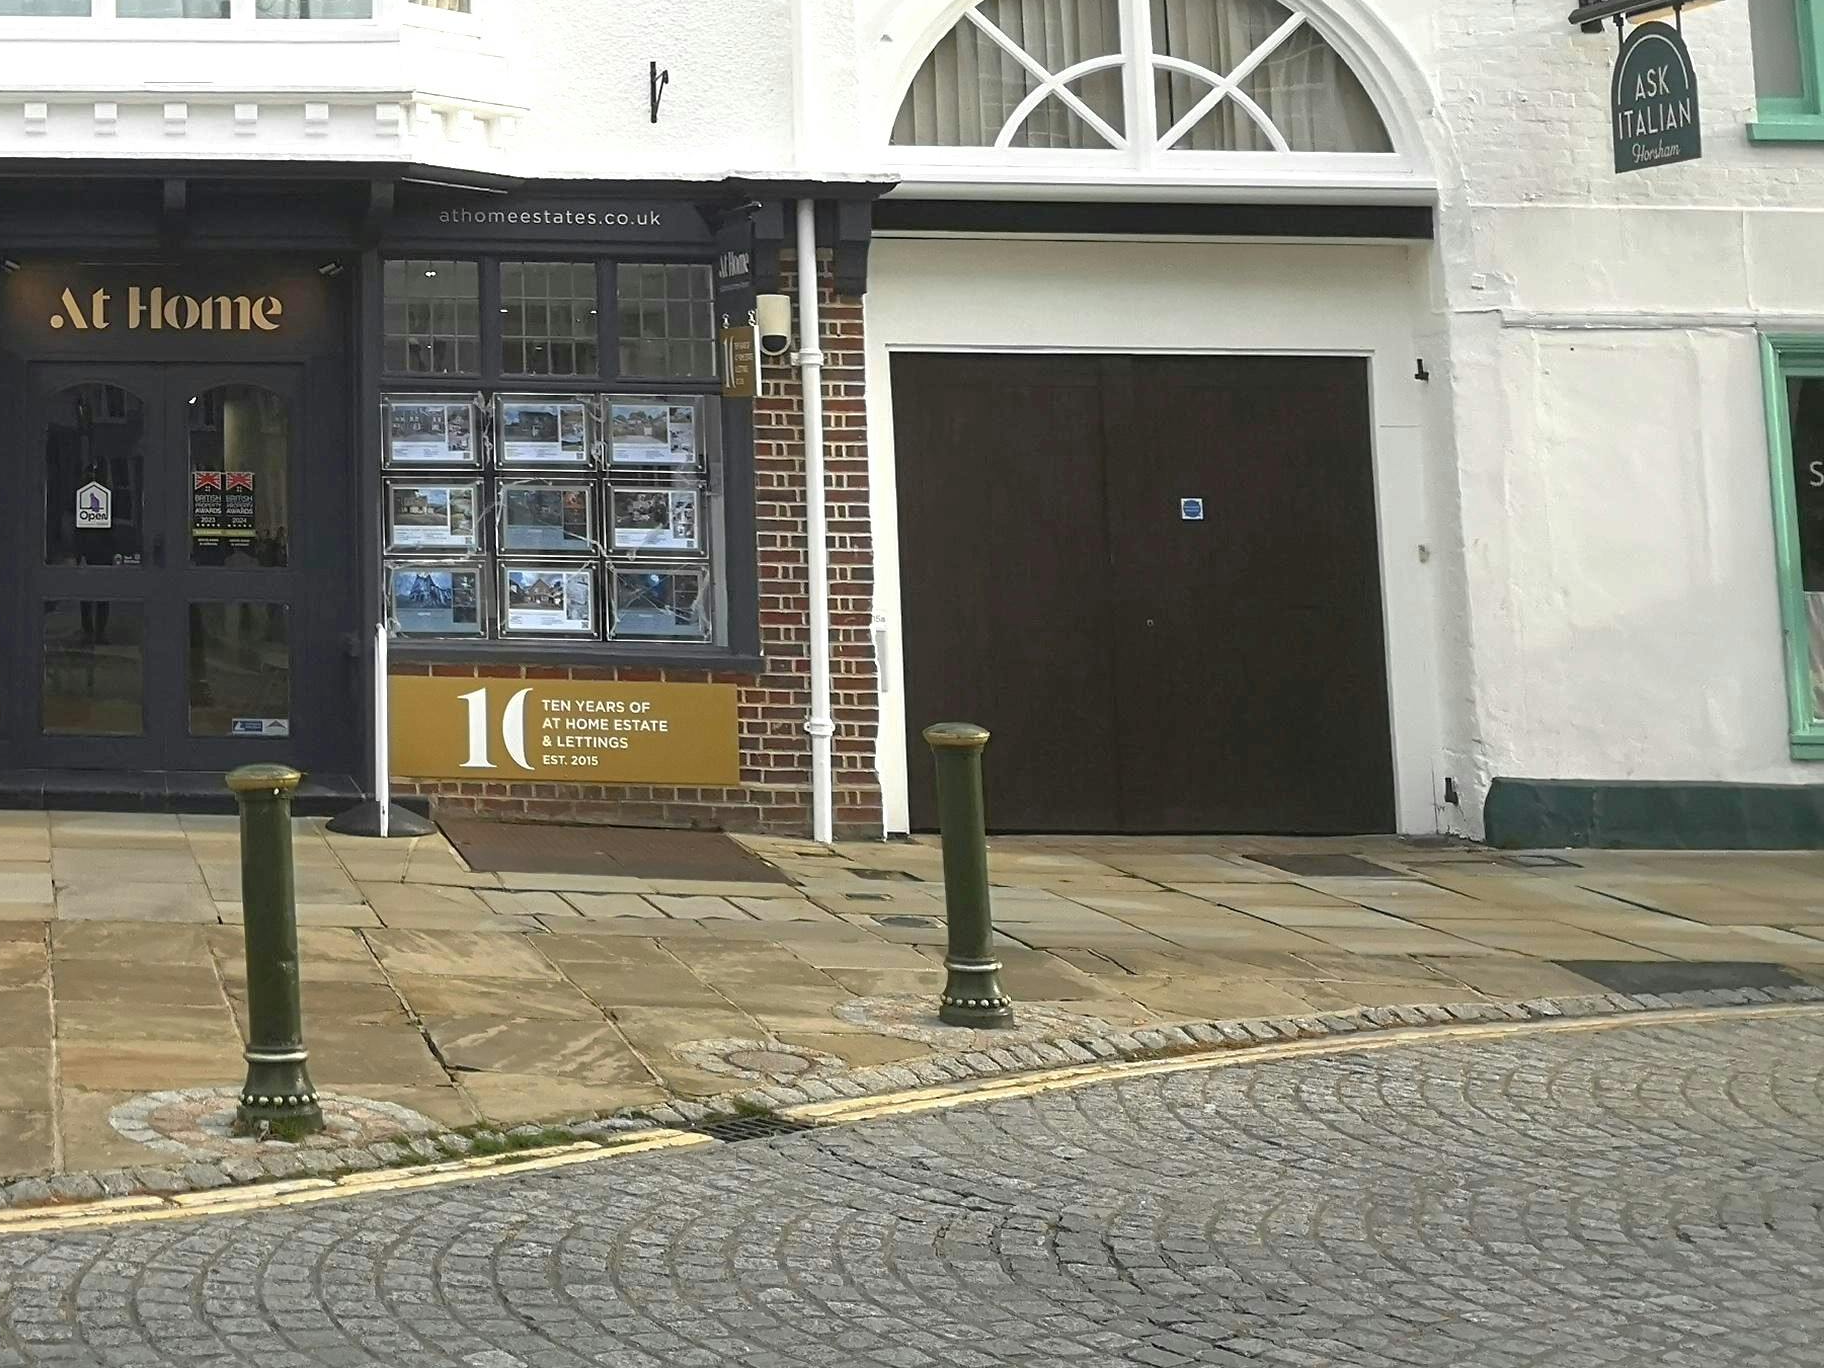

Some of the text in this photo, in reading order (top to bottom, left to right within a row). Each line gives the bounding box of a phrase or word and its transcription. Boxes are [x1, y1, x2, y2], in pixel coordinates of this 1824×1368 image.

[1635, 65, 1671, 101] ASK
[1618, 97, 1692, 140] ITALIAN
[1631, 139, 1681, 164] Horsham
[439, 208, 661, 226] athomeestates.co.uk
[50, 286, 283, 330] At Home
[79, 510, 109, 522] Open
[541, 699, 651, 714] TEN YEARS OF
[541, 717, 669, 733] AT HOME ESTATE
[541, 736, 629, 750] & LETTINGS
[542, 754, 599, 767] EST. 2015
